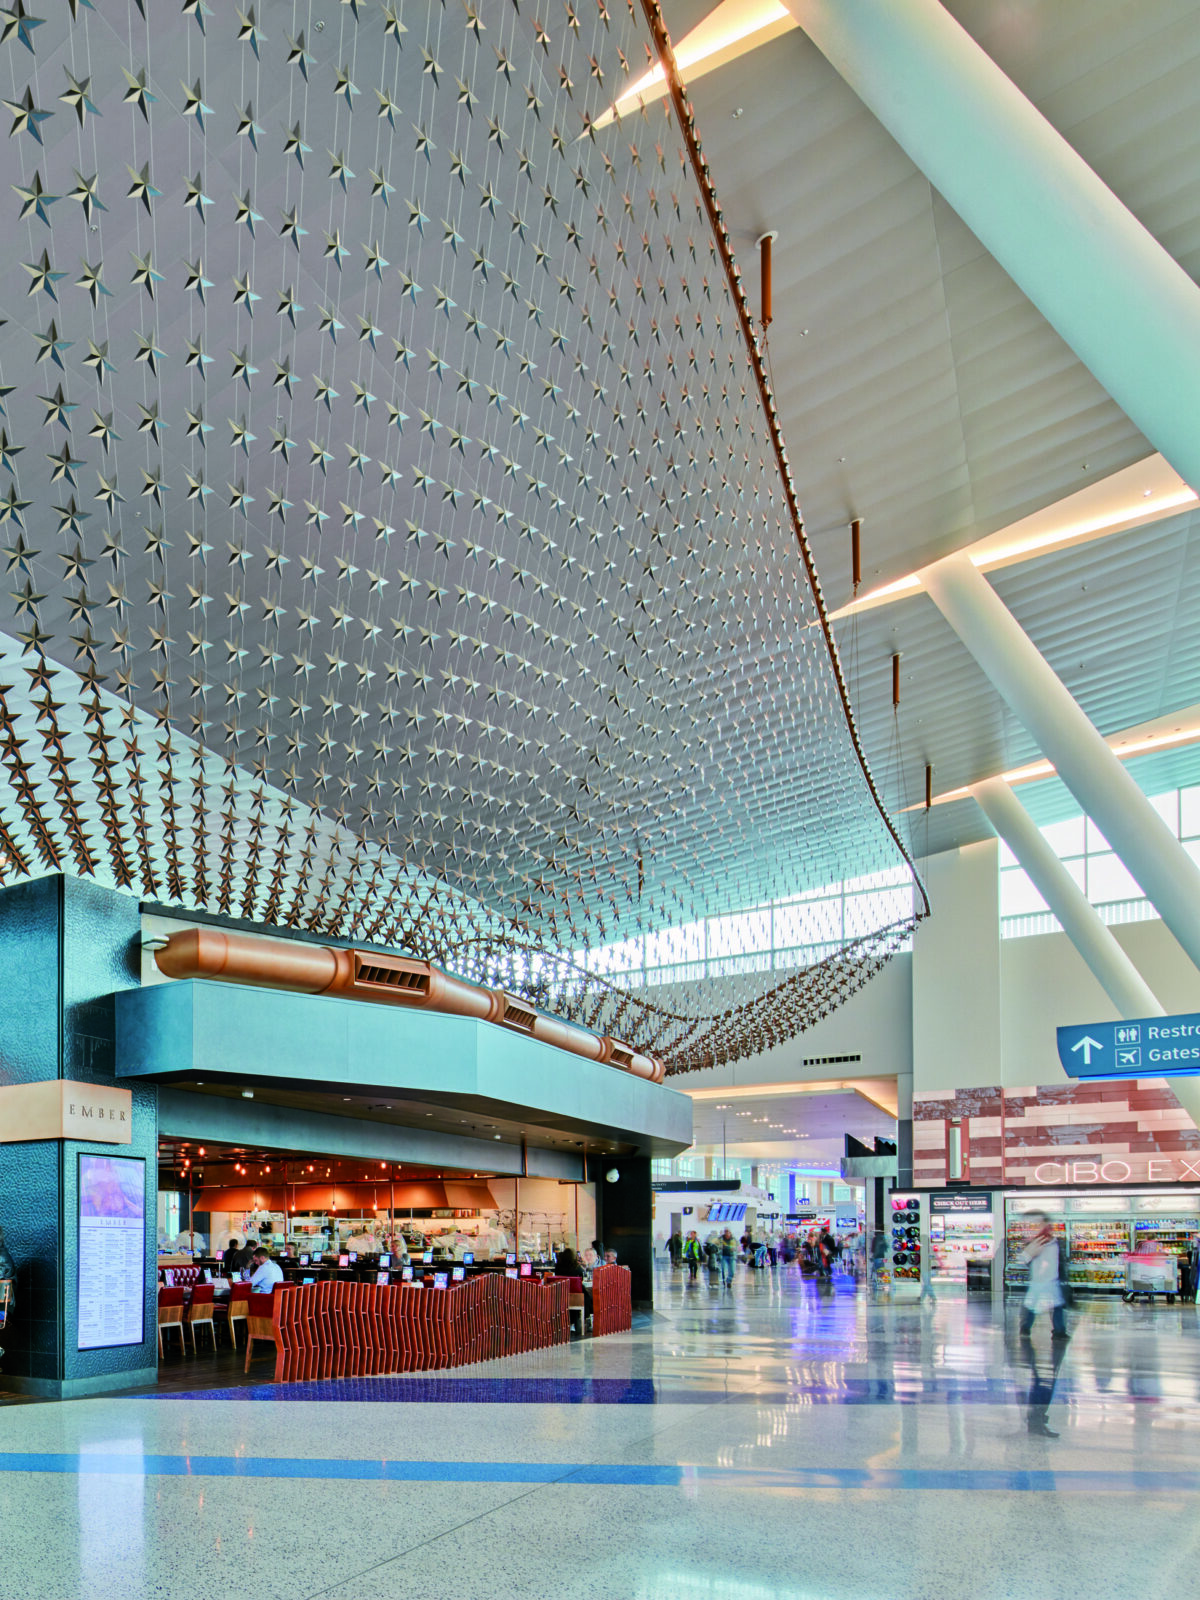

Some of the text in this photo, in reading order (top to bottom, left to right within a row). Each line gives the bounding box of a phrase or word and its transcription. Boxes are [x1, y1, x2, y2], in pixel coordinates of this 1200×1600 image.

[1148, 1047, 1200, 1062] Gates
[69, 1103, 126, 1121] EMBER
[1034, 1160, 1131, 1184] CIBO
